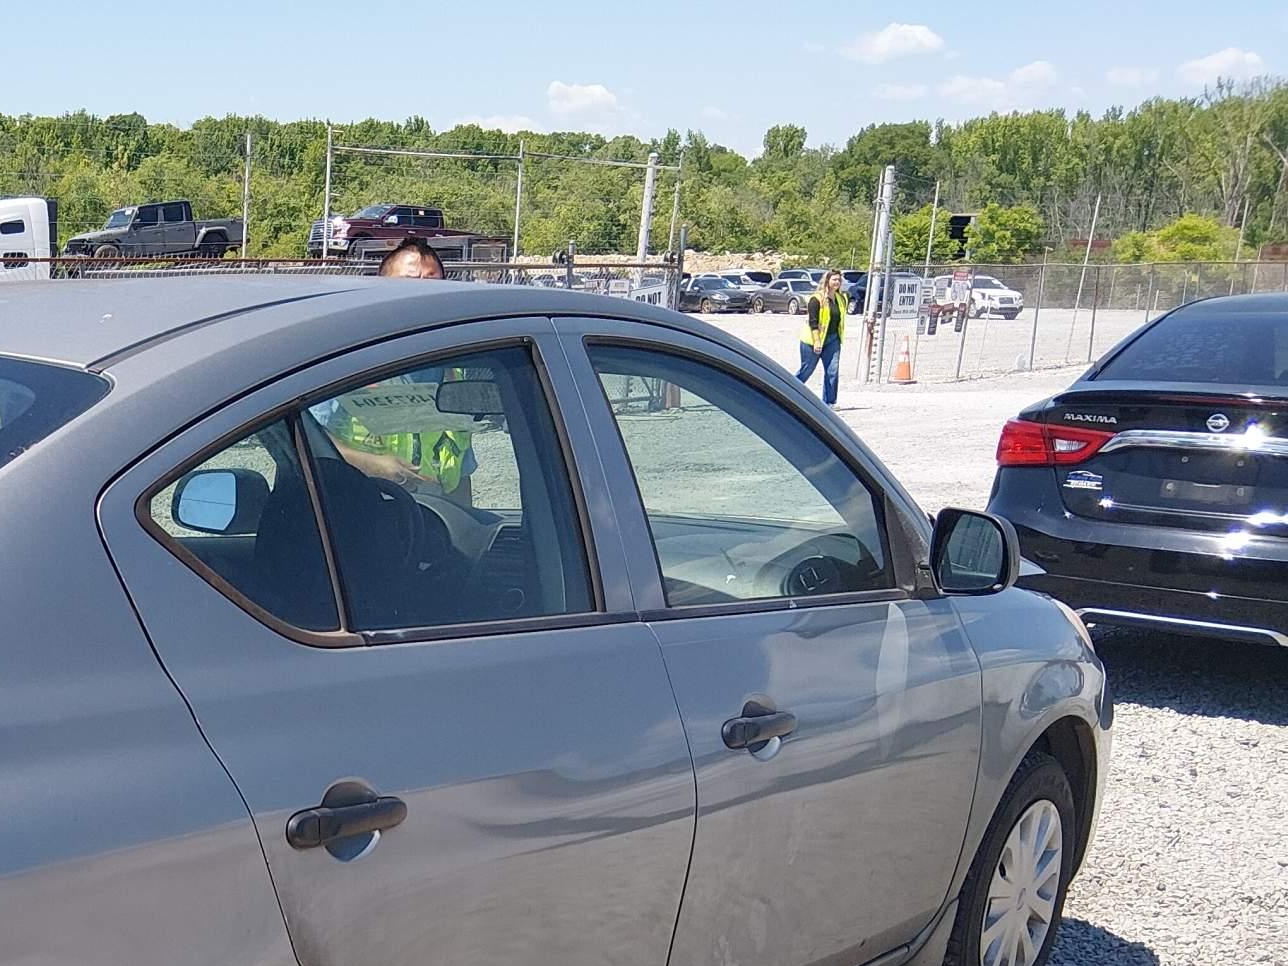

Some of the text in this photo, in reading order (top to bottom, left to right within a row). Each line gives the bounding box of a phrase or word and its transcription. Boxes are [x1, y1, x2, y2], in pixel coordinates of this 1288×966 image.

[898, 283, 906, 294] DO
[907, 283, 917, 294] NOT
[647, 292, 662, 305] NOT
[898, 296, 915, 306] ENTER
[1063, 413, 1118, 424] MAXIMA
